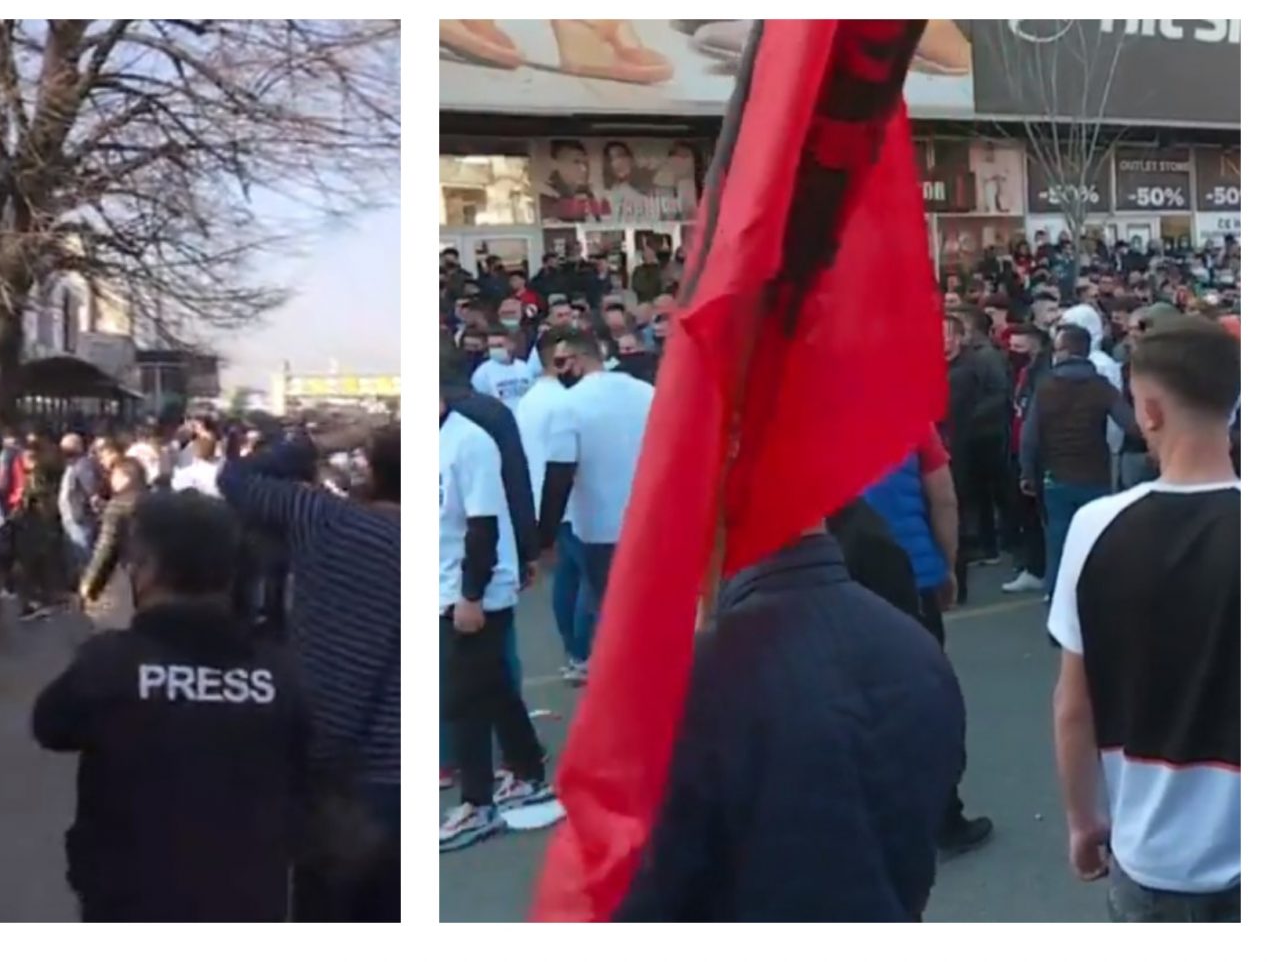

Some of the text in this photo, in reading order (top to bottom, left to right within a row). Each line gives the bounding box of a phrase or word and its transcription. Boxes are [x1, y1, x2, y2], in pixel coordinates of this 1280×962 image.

[1119, 160, 1157, 172] OUTLET
[1128, 187, 1185, 206] -50%
[1206, 187, 1240, 205] -50
[138, 664, 276, 703] PRESS
